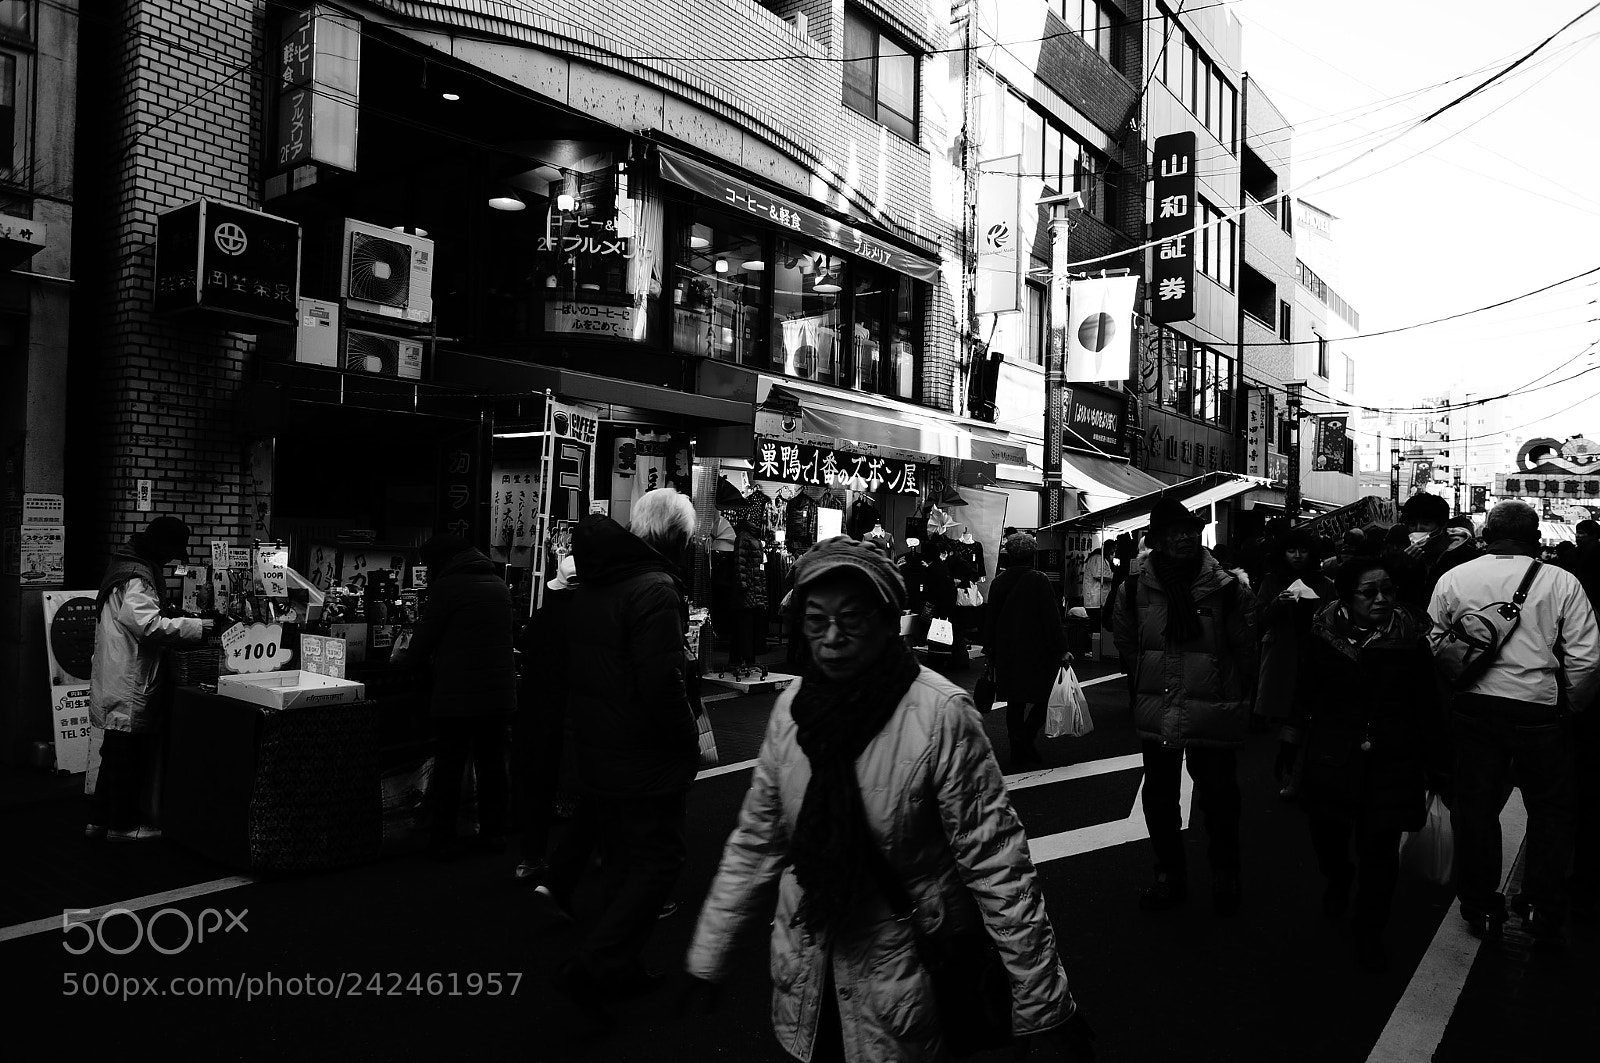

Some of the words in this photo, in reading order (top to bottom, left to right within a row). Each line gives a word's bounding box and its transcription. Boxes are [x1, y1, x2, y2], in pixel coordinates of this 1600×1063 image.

[280, 144, 291, 164] 2F
[725, 187, 802, 232] コーヒー&軽食
[1159, 153, 1189, 301] 山和証券
[758, 442, 920, 495] 巣鴨で1番のズボン屋
[263, 572, 284, 580] 100円
[234, 643, 277, 660] ¥100
[61, 729, 78, 740] TEL
